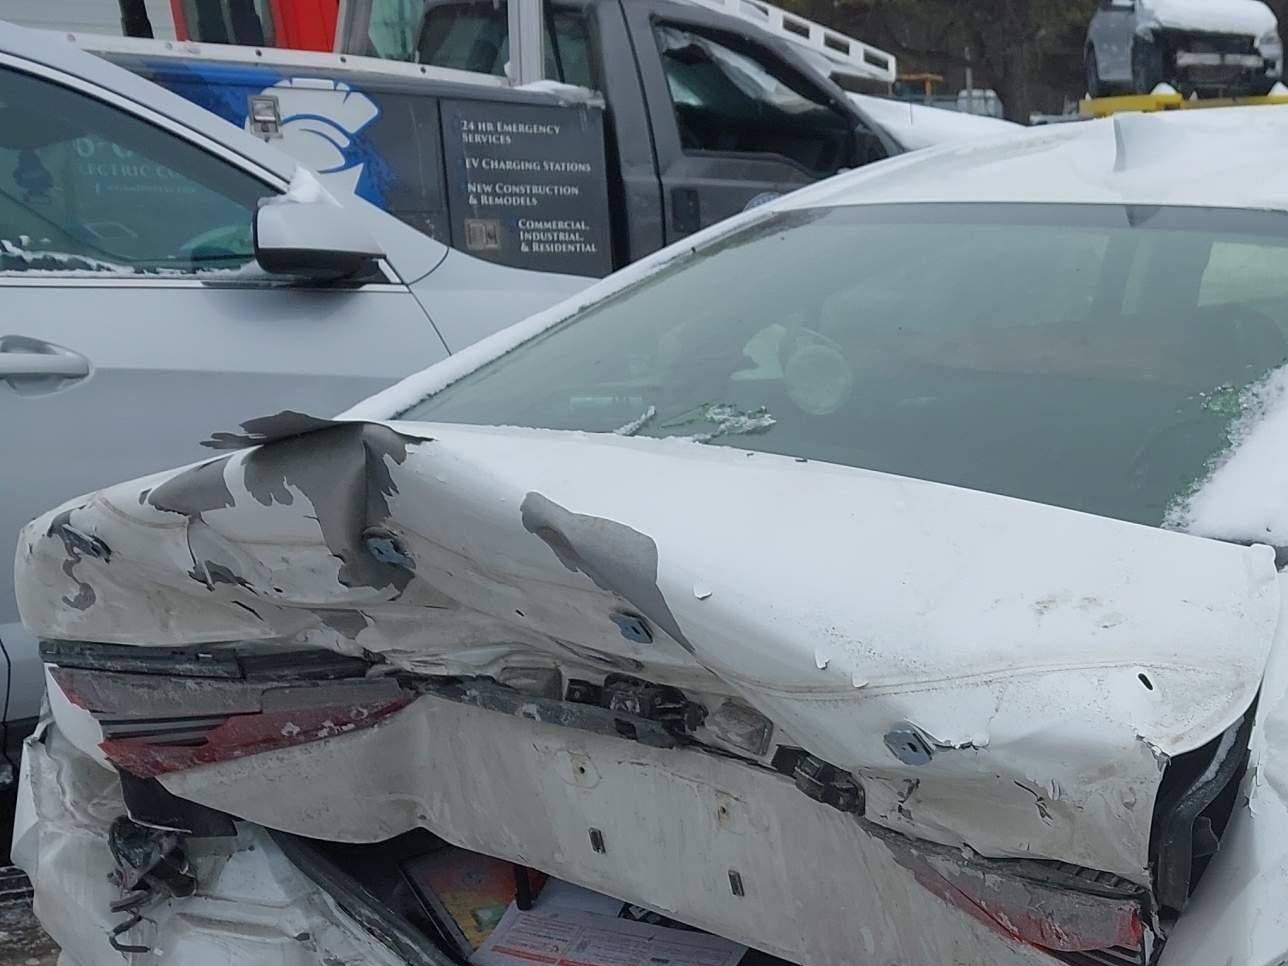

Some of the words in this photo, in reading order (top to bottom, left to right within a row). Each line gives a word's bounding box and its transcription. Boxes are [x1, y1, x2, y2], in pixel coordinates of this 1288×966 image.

[461, 120, 475, 131] 24
[497, 121, 560, 135] EMERGENCY
[462, 133, 511, 145] SERVICES
[482, 158, 541, 171] CHARGING
[543, 160, 591, 173] STATIONS
[467, 183, 495, 194] NEW
[496, 182, 579, 196] CONSTRUCTION
[480, 194, 538, 207] REMODELS
[532, 242, 597, 253] RESIDENTIAL
